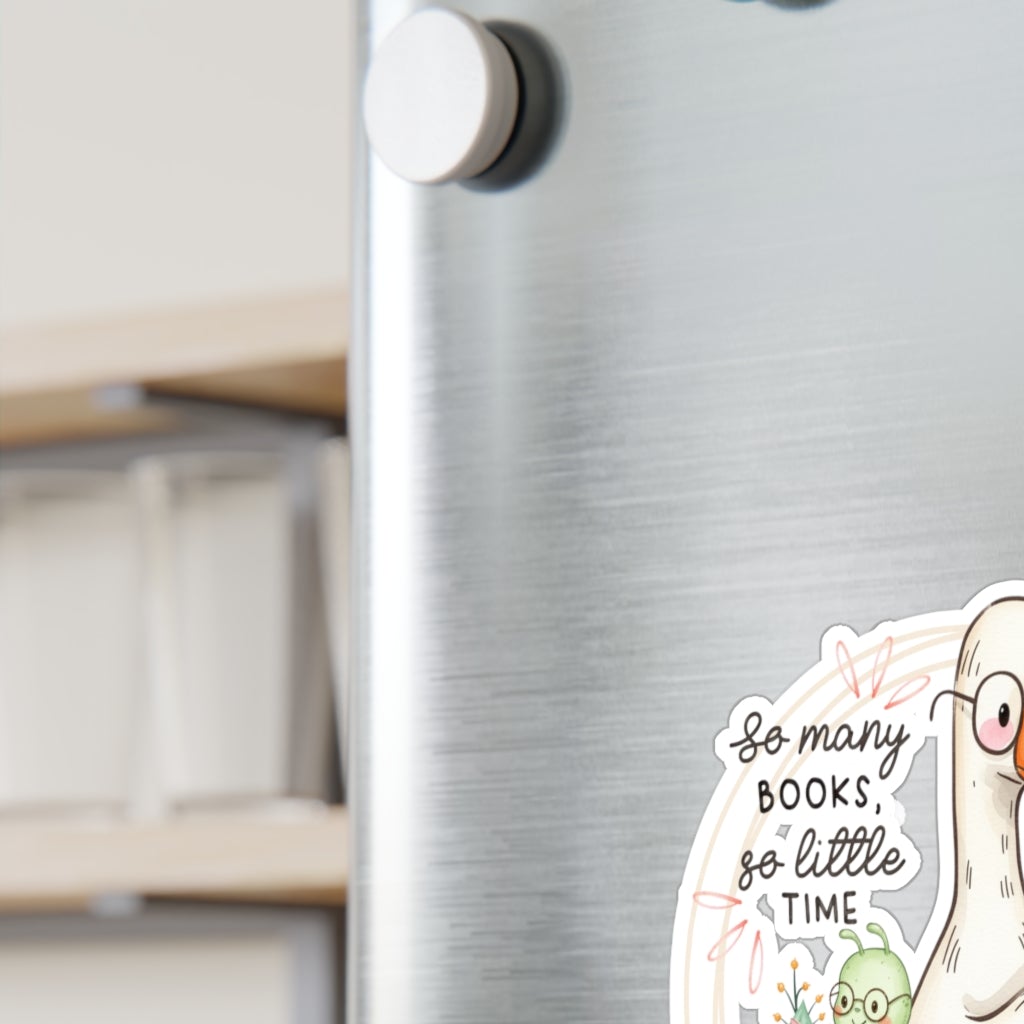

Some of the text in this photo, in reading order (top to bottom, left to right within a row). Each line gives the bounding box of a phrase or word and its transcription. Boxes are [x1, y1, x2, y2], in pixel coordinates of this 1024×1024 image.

[798, 719, 911, 780] many
[758, 775, 881, 815] BOOKS,
[795, 825, 906, 878] little
[781, 891, 858, 925] TIME
